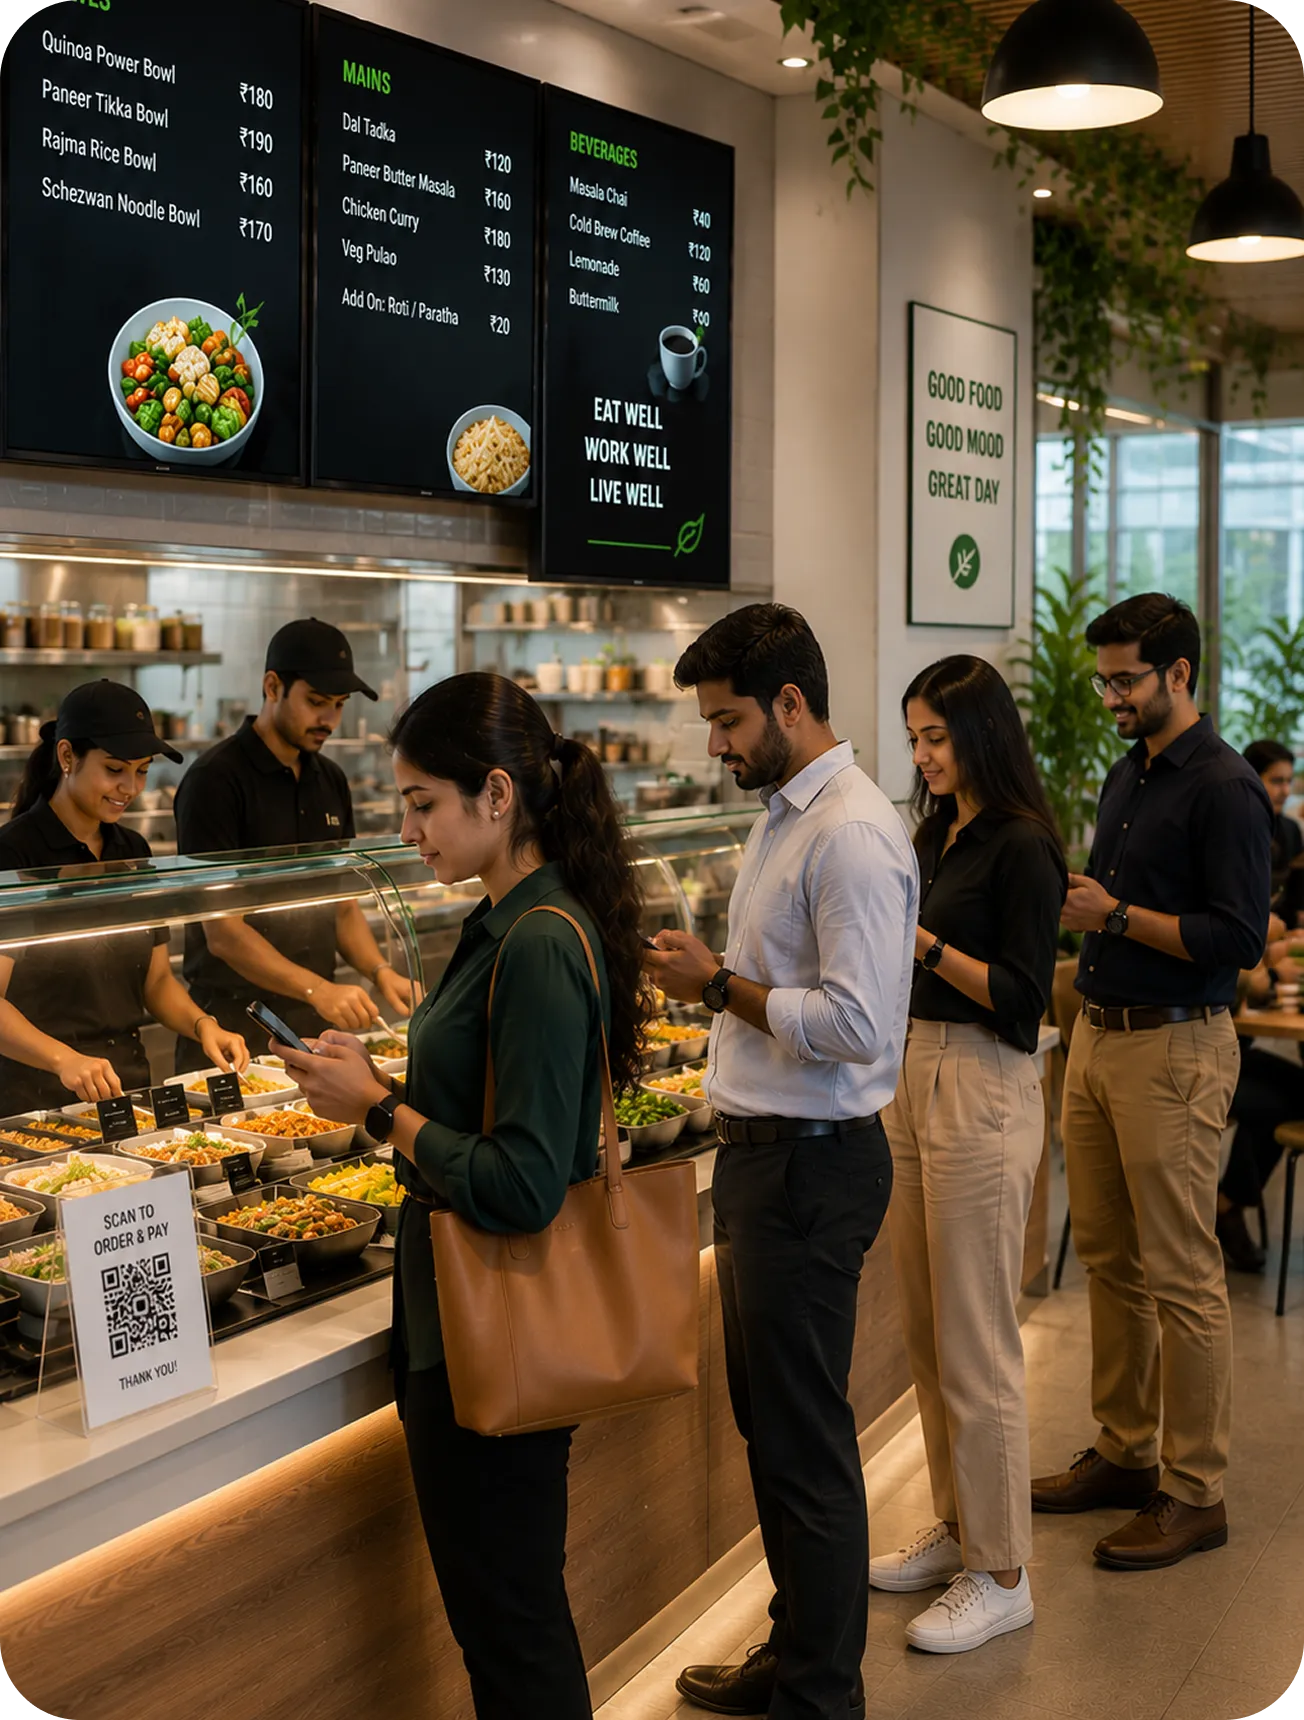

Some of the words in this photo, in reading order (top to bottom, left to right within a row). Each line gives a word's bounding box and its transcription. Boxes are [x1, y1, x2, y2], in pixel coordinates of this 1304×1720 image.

[42, 30, 92, 61] Quinoa
[96, 45, 139, 74] Power
[143, 58, 176, 84] Bowl
[342, 59, 391, 94] MAINS
[42, 78, 92, 109] Paneer
[95, 92, 132, 119] Tikka
[136, 103, 168, 128] Bowl
[239, 82, 273, 110] ₹180
[239, 126, 273, 154] ₹190
[342, 112, 361, 133] Dal
[363, 117, 396, 143] Tadka
[42, 127, 86, 156] Rajma
[90, 138, 120, 163] Rice
[124, 146, 156, 172] Bowl
[484, 149, 512, 174] ₹120
[570, 131, 638, 169] BEVERAGES
[239, 171, 273, 198] ₹160
[342, 154, 380, 180] Paneer
[383, 164, 416, 189] Butter
[419, 173, 456, 198] Masala
[570, 176, 605, 201] Masala
[607, 187, 628, 207] Chai
[42, 177, 113, 211] Schezwan
[117, 193, 165, 221] Noodle
[168, 203, 200, 228] Bowl
[342, 196, 387, 223] Chicken
[389, 207, 419, 233] Curry
[484, 188, 512, 211] ₹160
[239, 217, 273, 242] ₹170
[569, 213, 592, 234] Cold
[594, 220, 618, 241] Brew
[620, 227, 651, 249] Coffee
[693, 209, 711, 229] ₹40
[341, 238, 363, 264] Veg
[366, 244, 397, 266] Pulao
[484, 226, 511, 249] ₹180
[688, 242, 711, 262] ₹120
[483, 265, 511, 287] ₹130
[569, 250, 620, 277] Lemonade
[693, 275, 710, 294] ₹60
[341, 288, 364, 307] Add
[367, 292, 386, 313] On:
[388, 297, 410, 317] Roti
[411, 301, 417, 319] /
[419, 303, 459, 326] Paratha
[569, 288, 620, 313] Buttermilk
[490, 315, 510, 335] ₹20
[928, 370, 965, 404] GOOD
[969, 380, 1003, 411] FOOD
[594, 397, 621, 424] EAT
[625, 401, 663, 430] WELL
[585, 436, 629, 465] WORK
[633, 442, 671, 470] WELL
[926, 420, 963, 453] GOOD
[966, 428, 1004, 459] MOOD
[590, 477, 622, 504] LIVE
[626, 482, 664, 508] WELL
[928, 469, 971, 501] GREAT
[975, 477, 999, 505] DAY
[104, 1209, 136, 1230] SCAN
[138, 1204, 154, 1221] TO
[94, 1231, 134, 1256] ORDER
[137, 1230, 144, 1244] &
[147, 1222, 169, 1241] PAY
[119, 1369, 153, 1390] THANK
[154, 1361, 178, 1381] YOU!
